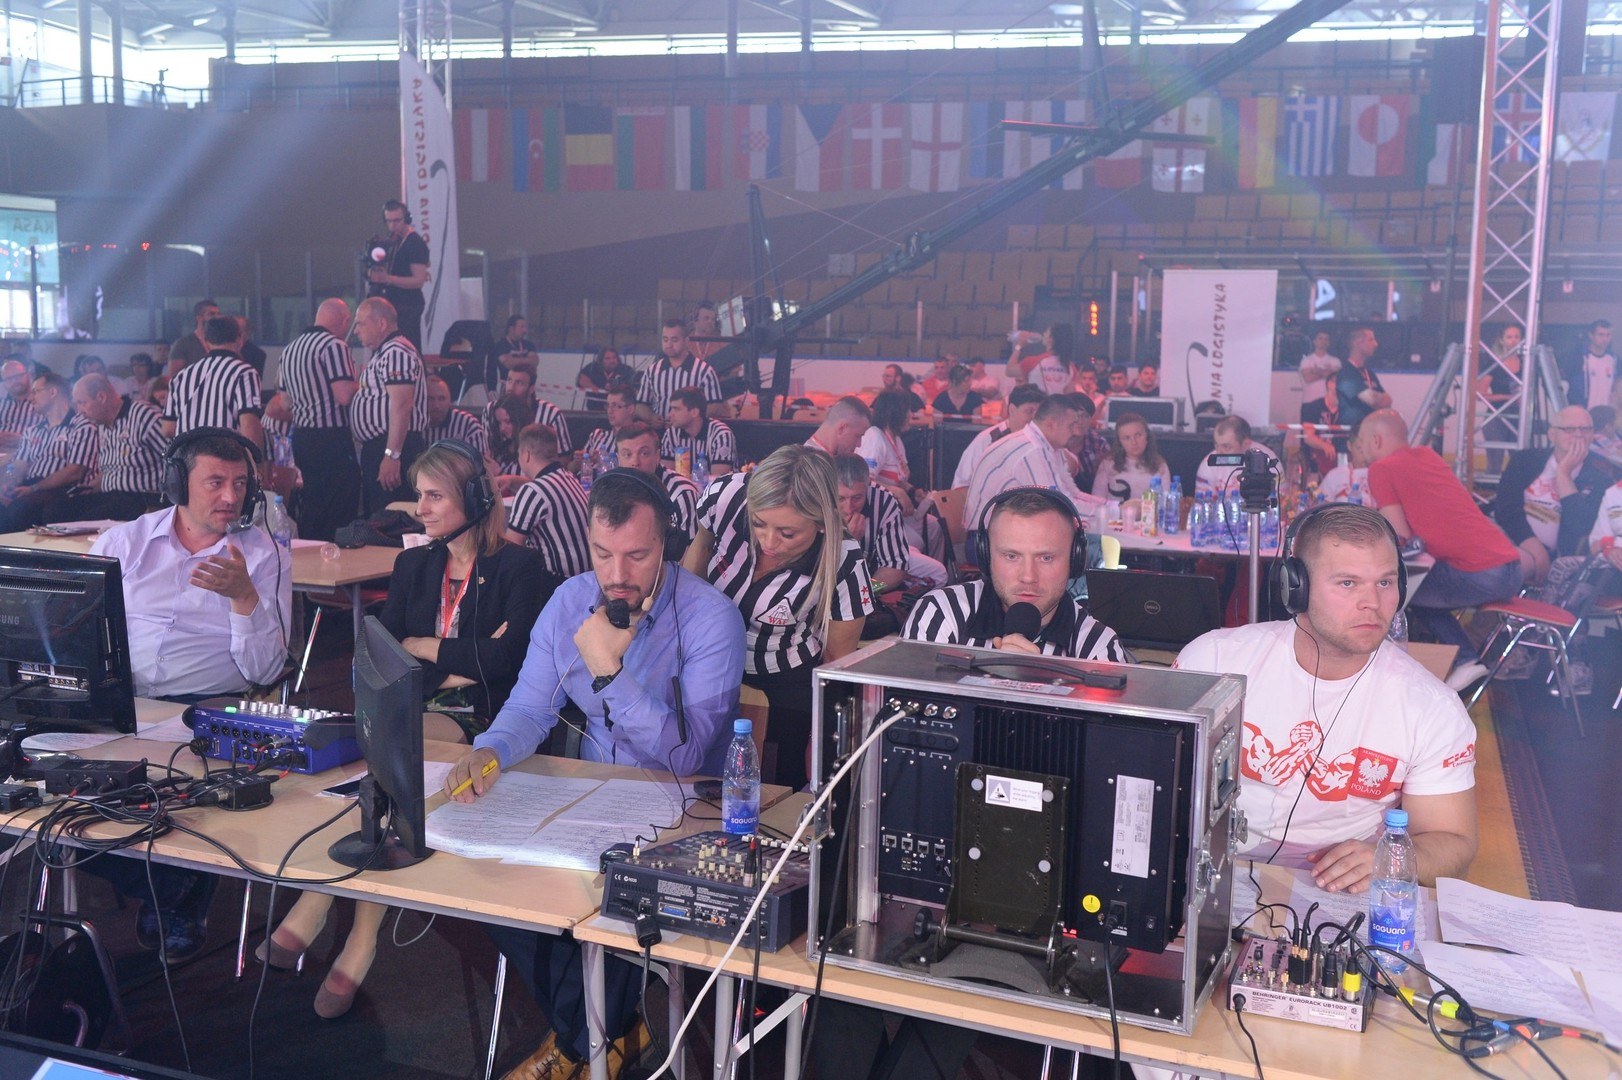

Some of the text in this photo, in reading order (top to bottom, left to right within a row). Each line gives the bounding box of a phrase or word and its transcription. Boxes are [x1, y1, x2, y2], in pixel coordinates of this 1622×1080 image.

[1212, 282, 1227, 369] LOGISTYKA
[0, 615, 20, 626] UNG
[769, 616, 788, 625] WAF
[1350, 782, 1382, 796] POLAND
[1252, 990, 1287, 1001] BEHRINGER
[1288, 997, 1322, 1008] EURORACK
[1322, 1002, 1348, 1011] UB1002
